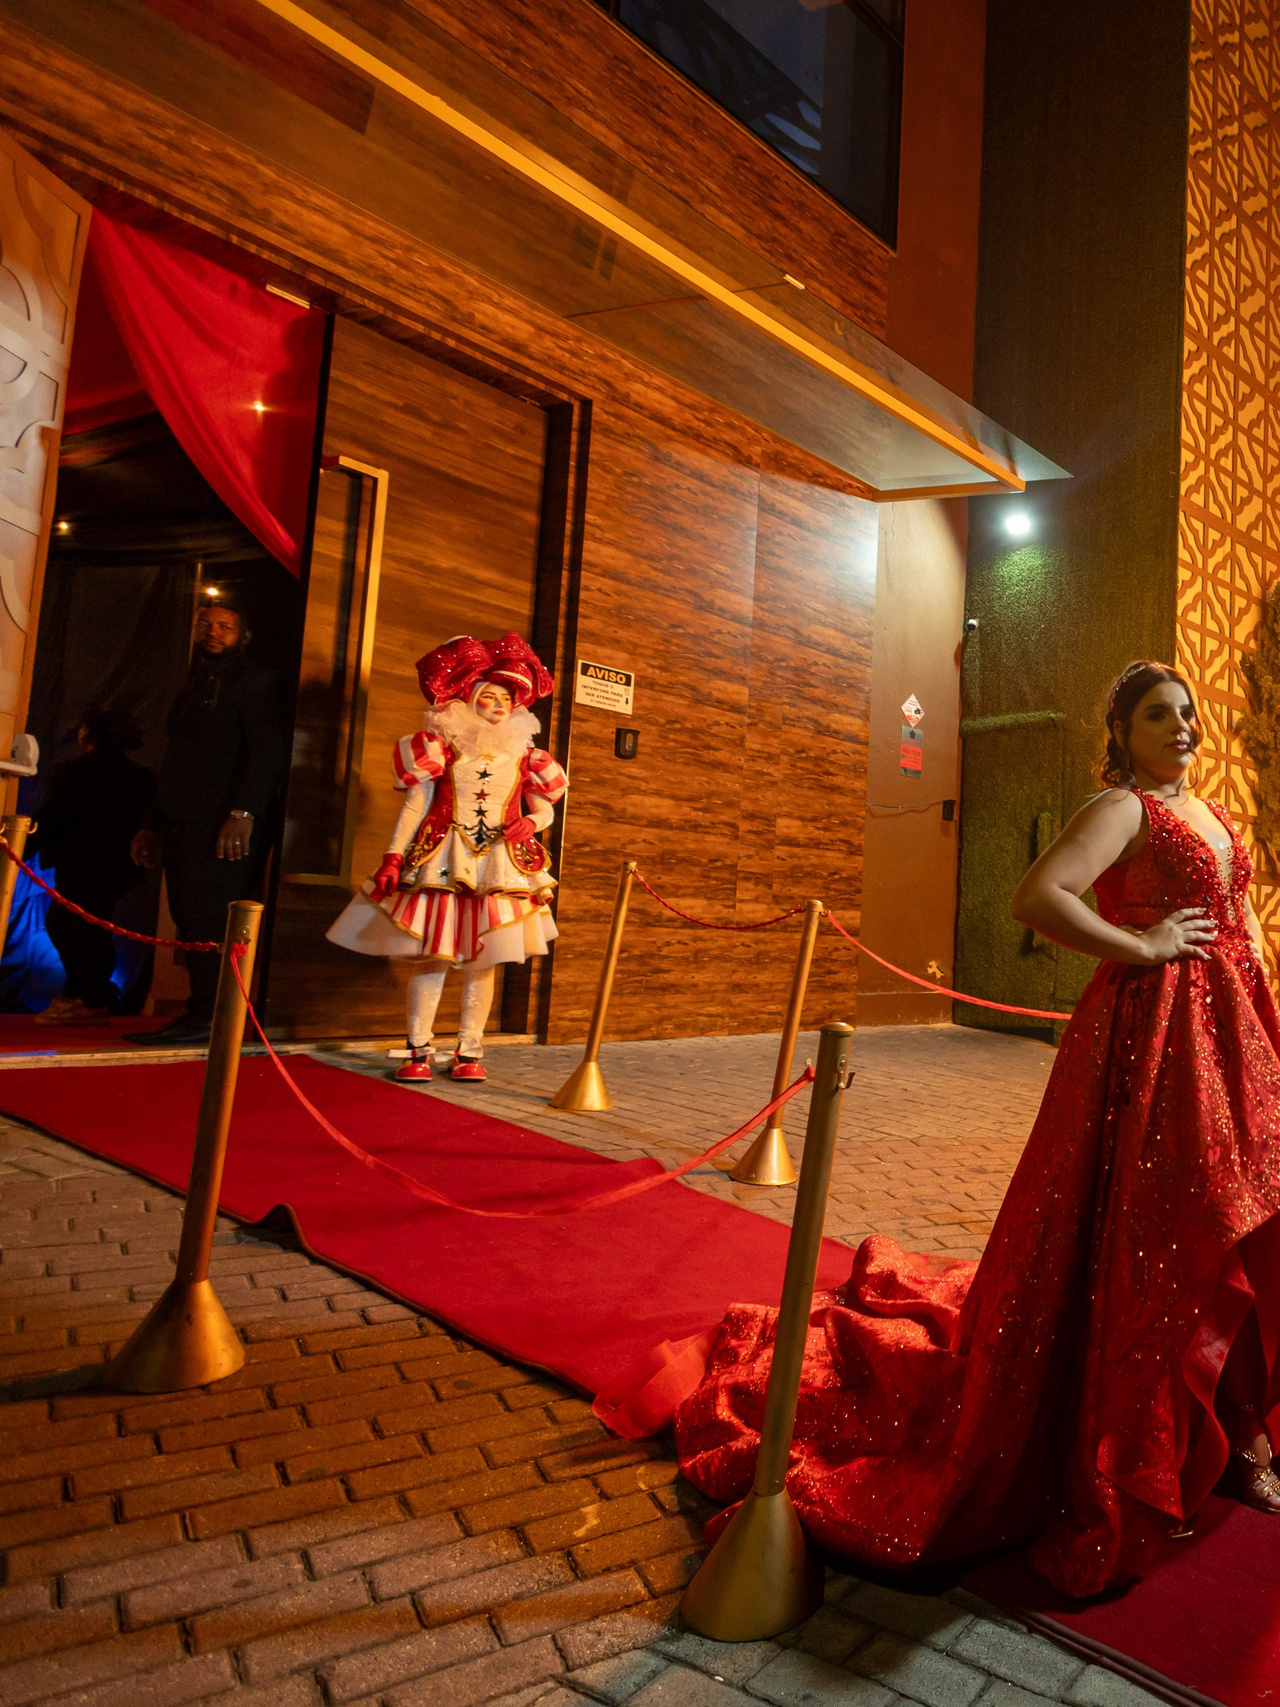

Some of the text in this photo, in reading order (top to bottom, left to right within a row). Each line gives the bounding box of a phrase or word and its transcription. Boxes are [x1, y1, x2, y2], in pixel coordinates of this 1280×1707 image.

[587, 666, 626, 684] AVISO
[592, 680, 609, 688] TOQUE
[581, 684, 609, 695] INTERFONE
[596, 694, 621, 703] ATENDIDO
